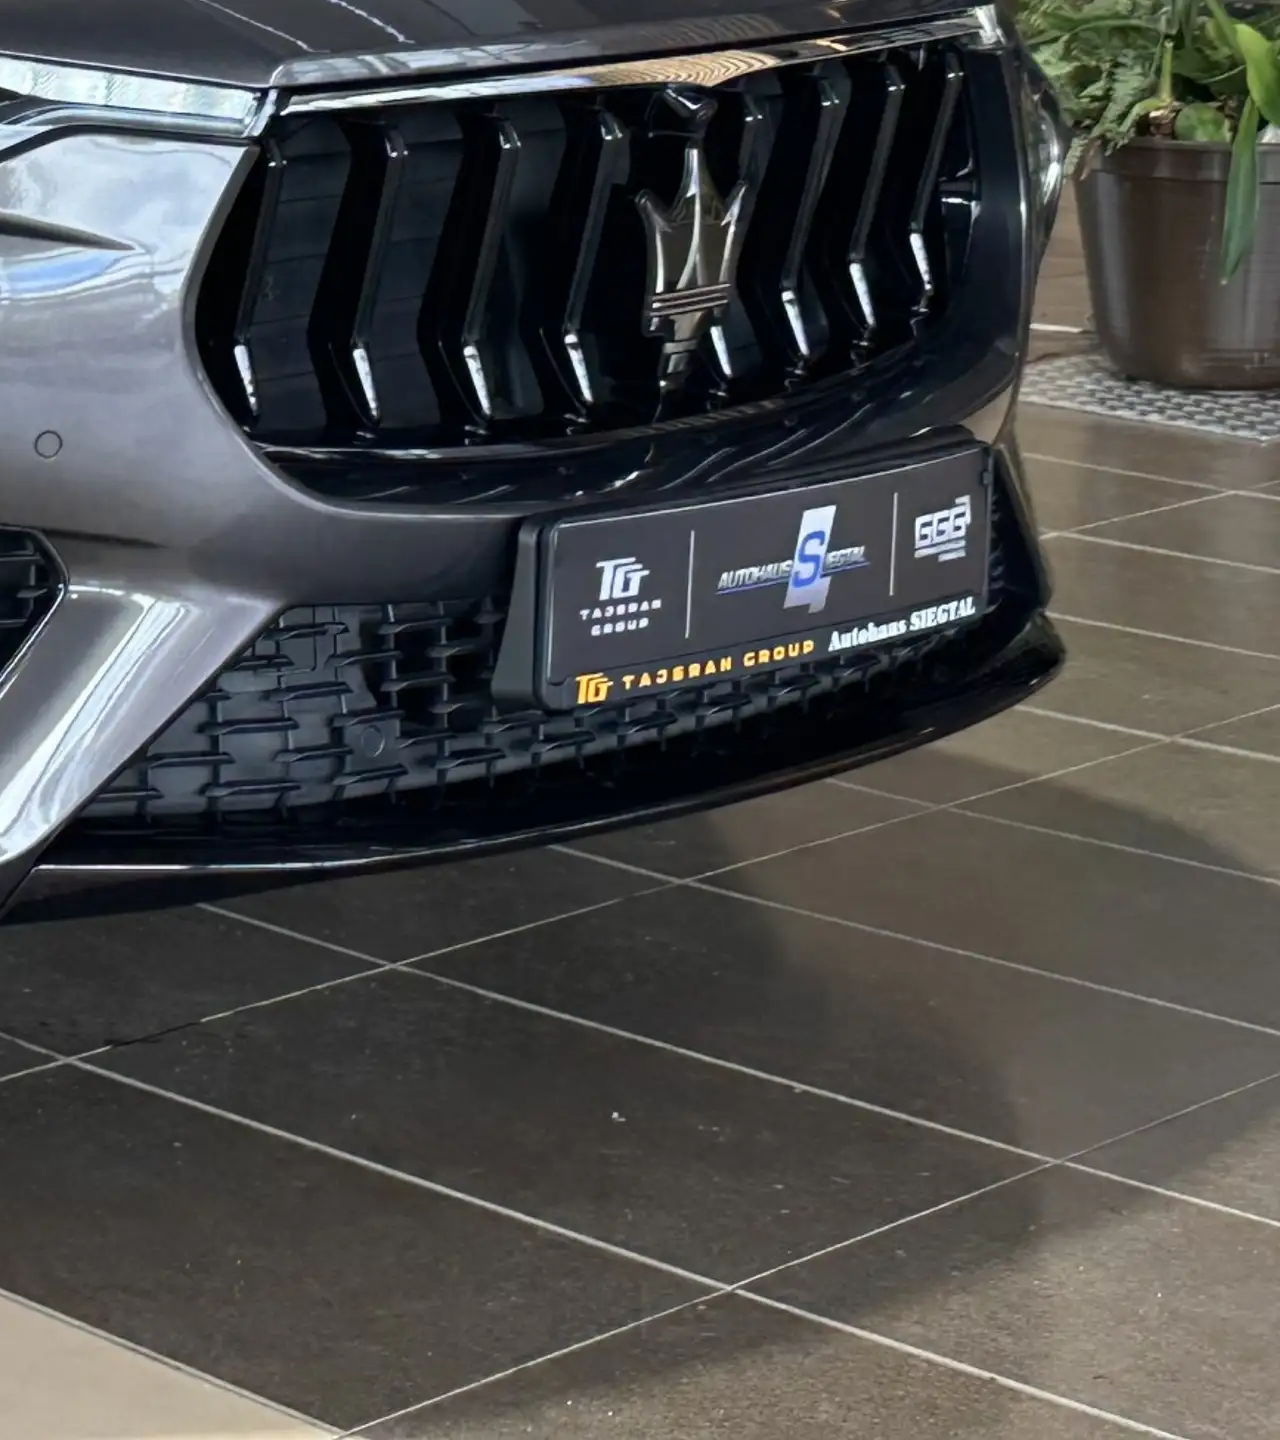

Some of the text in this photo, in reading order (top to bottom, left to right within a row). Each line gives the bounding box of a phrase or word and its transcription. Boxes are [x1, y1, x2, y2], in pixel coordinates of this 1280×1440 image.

[718, 560, 795, 589] AUTOHAUS
[591, 617, 650, 636] GROUP
[828, 596, 976, 652] Autohaus SIEGTAL
[743, 639, 815, 668] GROUP
